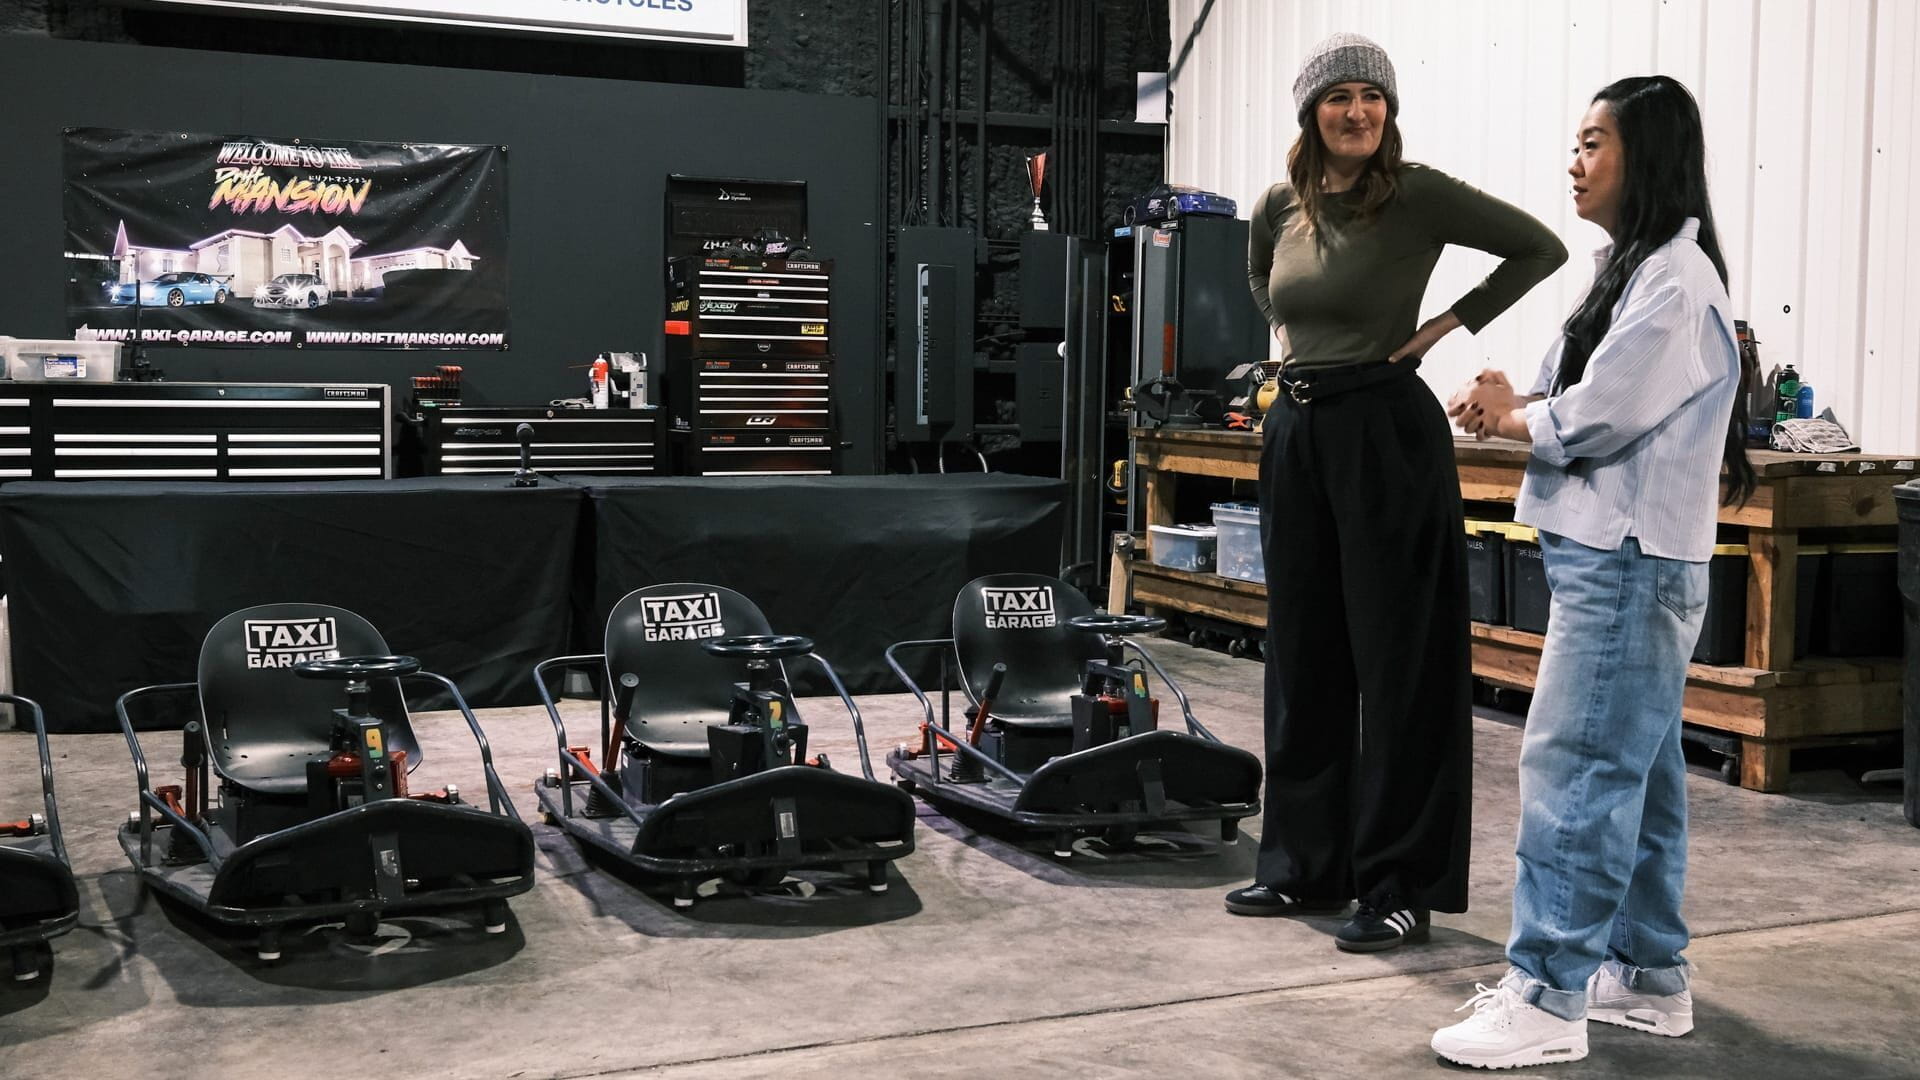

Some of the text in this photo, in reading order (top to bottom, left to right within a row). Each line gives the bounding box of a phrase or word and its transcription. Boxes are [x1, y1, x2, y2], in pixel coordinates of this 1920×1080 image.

[215, 142, 362, 169] WELCOME TO THE
[214, 166, 264, 184] Drift
[208, 175, 372, 216] MANSION
[707, 301, 738, 309] EXEDY
[306, 331, 503, 345] WWW.DRIFTMANSION.COM
[646, 598, 713, 622] TAXI
[987, 591, 1046, 610] TAXI
[645, 623, 725, 642] GARAGE
[985, 615, 1056, 628] GARAGE
[251, 623, 329, 647] TAXI
[1134, 673, 1146, 698] 4
[769, 701, 784, 729] 2
[366, 728, 384, 759] 9
